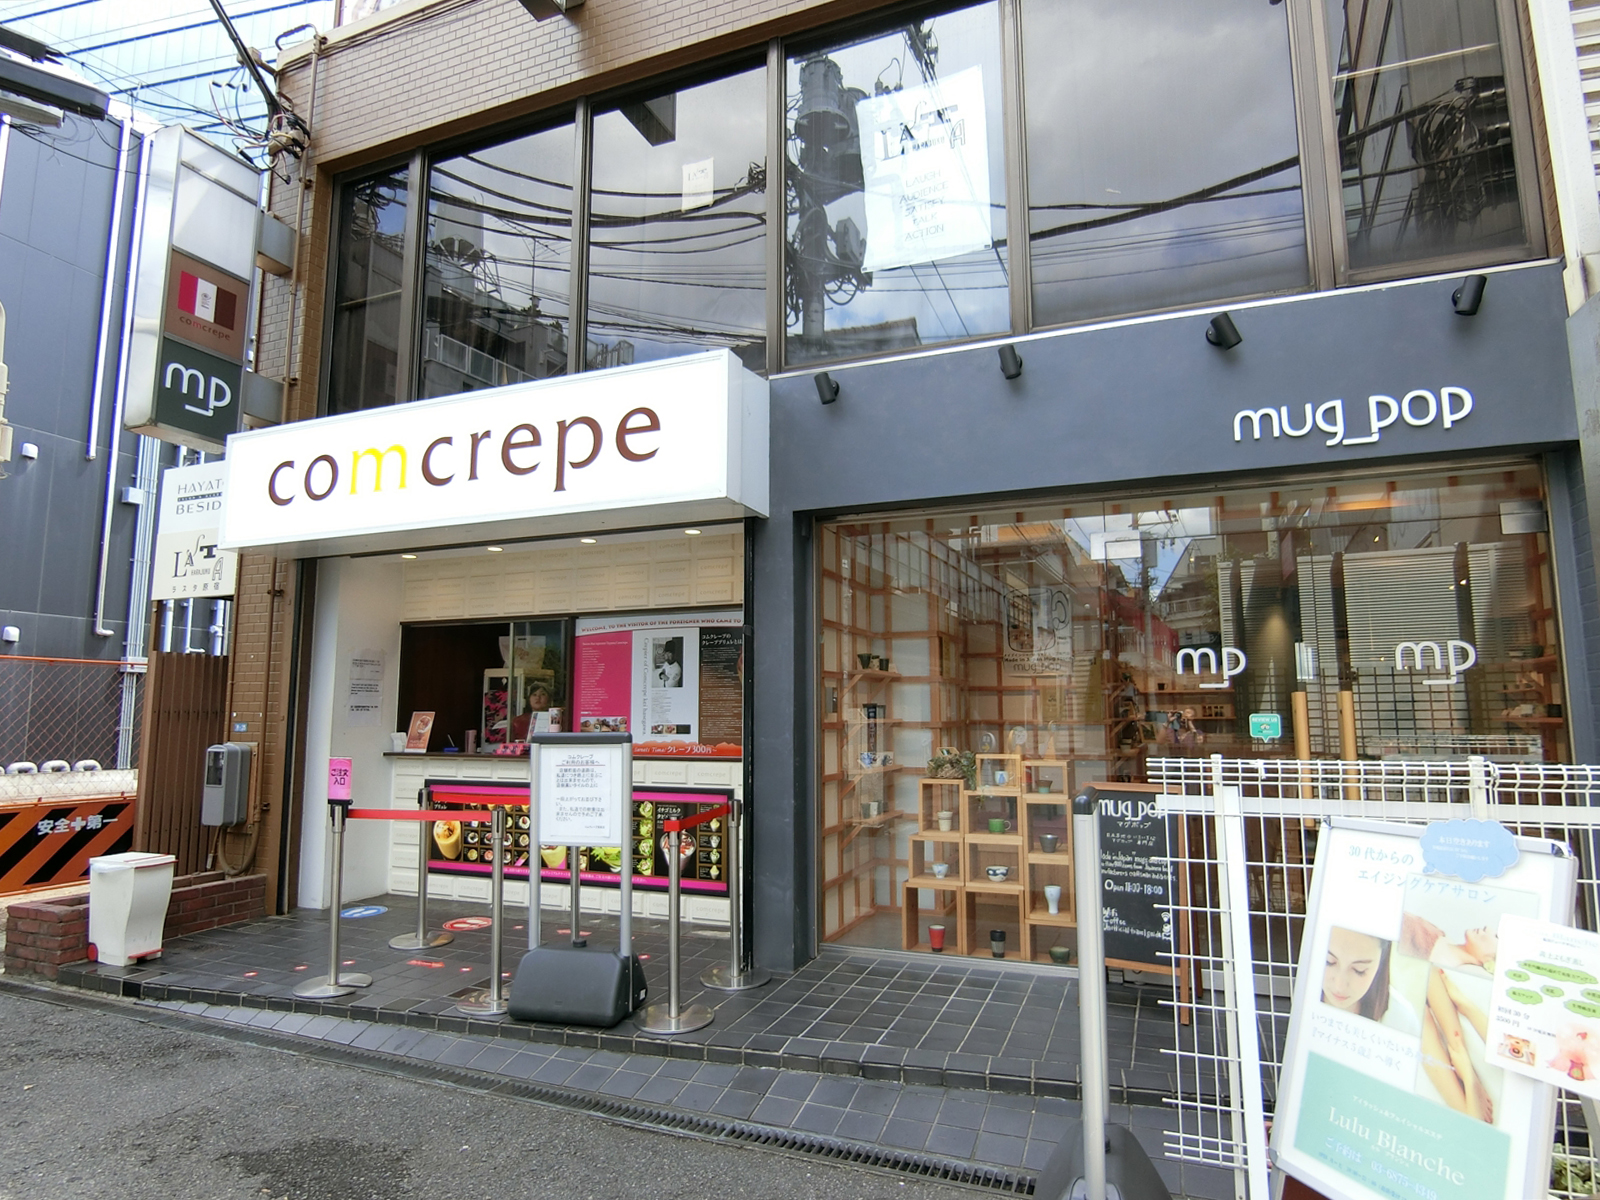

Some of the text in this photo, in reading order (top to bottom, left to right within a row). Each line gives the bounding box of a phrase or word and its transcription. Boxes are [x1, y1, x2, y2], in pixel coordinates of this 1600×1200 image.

[906, 169, 941, 188] LAUGH
[899, 181, 949, 204] AUDIENCE
[905, 224, 944, 242] ACTION
[179, 315, 231, 340] comcrepe
[268, 406, 662, 506] comcrepe
[178, 479, 224, 494] HAYAT
[172, 583, 220, 593] ラスタ原宿
[331, 769, 349, 777] ご注文
[333, 777, 346, 785] 入口
[1117, 821, 1152, 829] マグポップ
[1439, 836, 1490, 849] 本日空きあります
[1104, 879, 1124, 892] Open
[1357, 869, 1498, 904] エイジングケアサロン
[695, 905, 725, 914] comcrepe
[1103, 915, 1126, 926] Coffee
[1325, 1136, 1362, 1164] ご予約は
[1328, 1106, 1371, 1140] Lulu
[1377, 1129, 1466, 1187] Blanche
